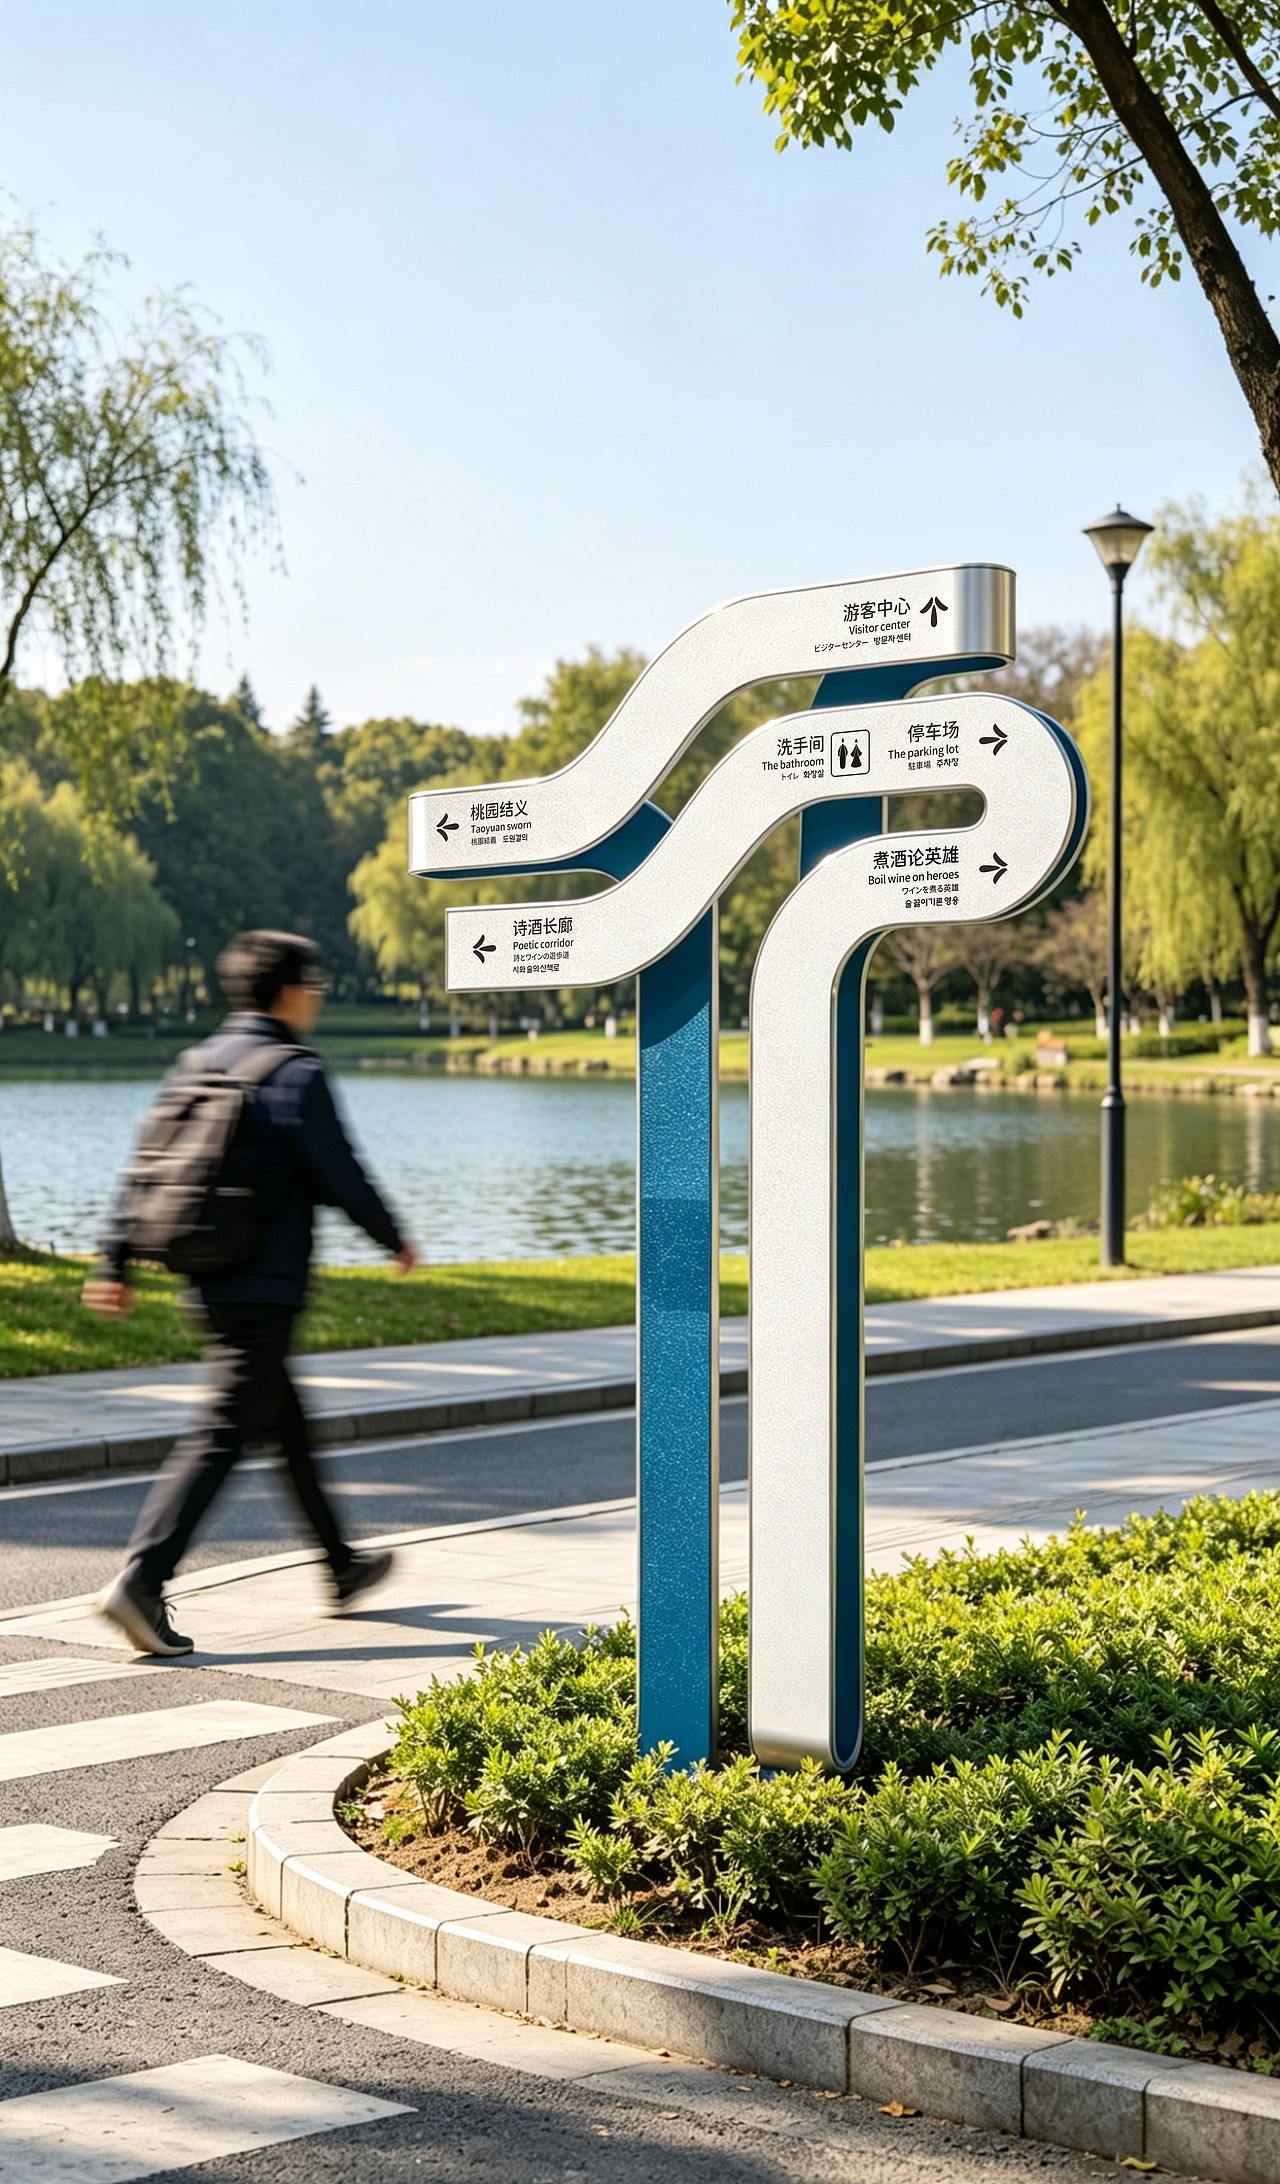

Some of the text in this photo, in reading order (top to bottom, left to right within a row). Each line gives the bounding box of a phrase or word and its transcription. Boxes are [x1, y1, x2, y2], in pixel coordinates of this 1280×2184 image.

[844, 597, 910, 622] 游客中心
[849, 621, 910, 634] Visitor center
[815, 640, 868, 652] ビジターセンター
[908, 721, 959, 743] 停车场
[777, 736, 824, 756] 洗手间
[888, 745, 959, 760] The parking lot
[762, 759, 824, 770] The bathroom
[471, 800, 528, 821] 桃园结义
[471, 822, 531, 835] Taoyuan sworn
[873, 846, 959, 869] 煮酒论英雄
[869, 874, 886, 885] Boil
[888, 873, 910, 883] wine
[927, 871, 959, 880] heroes
[513, 916, 572, 936] 诗酒长廊
[513, 938, 574, 950] Poetic corridor
